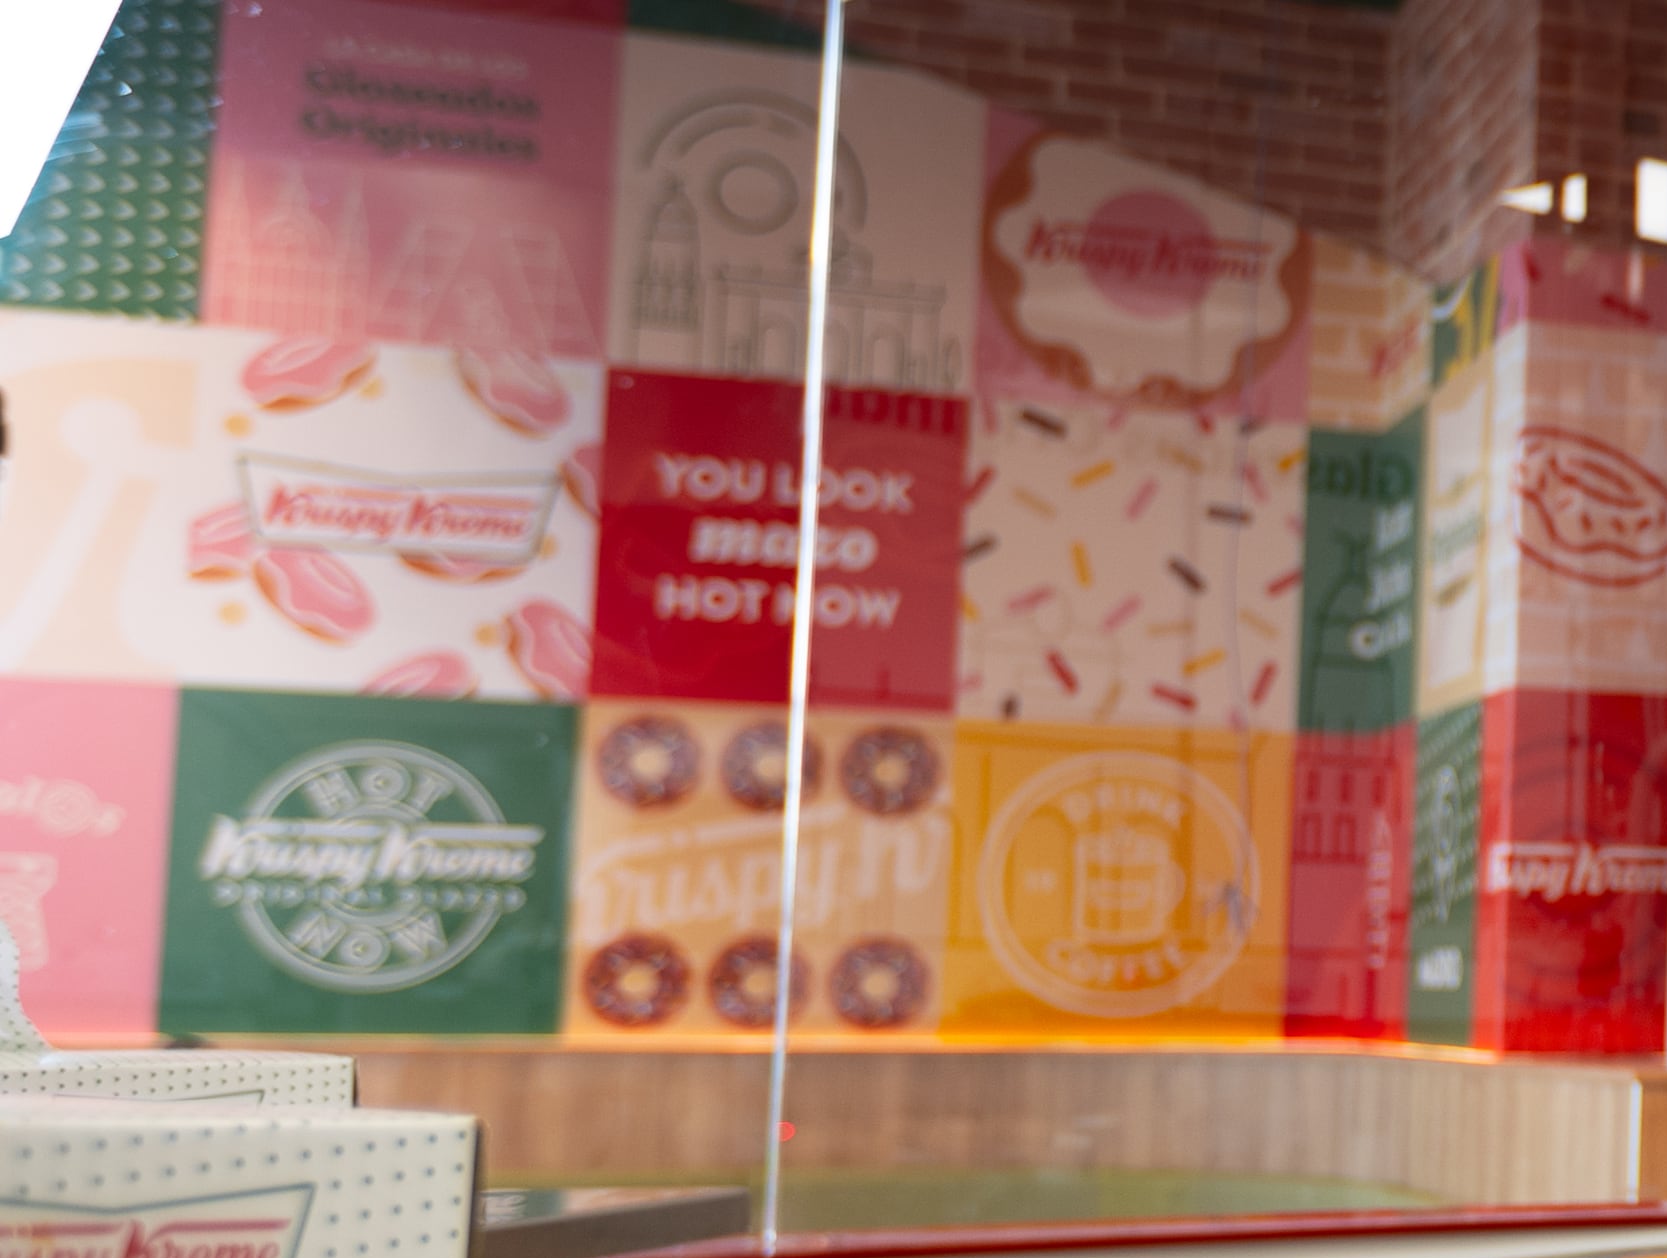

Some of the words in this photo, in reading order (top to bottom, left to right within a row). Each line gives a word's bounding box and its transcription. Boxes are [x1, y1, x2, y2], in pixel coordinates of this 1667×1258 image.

[653, 452, 767, 502] YOU
[772, 460, 916, 515] LOOK
[654, 572, 768, 625] HOT
[773, 583, 902, 630] NOW
[303, 757, 458, 817] HOT
[198, 812, 389, 894] Krispy
[370, 818, 545, 889] Kreme
[287, 904, 450, 973] NOW
